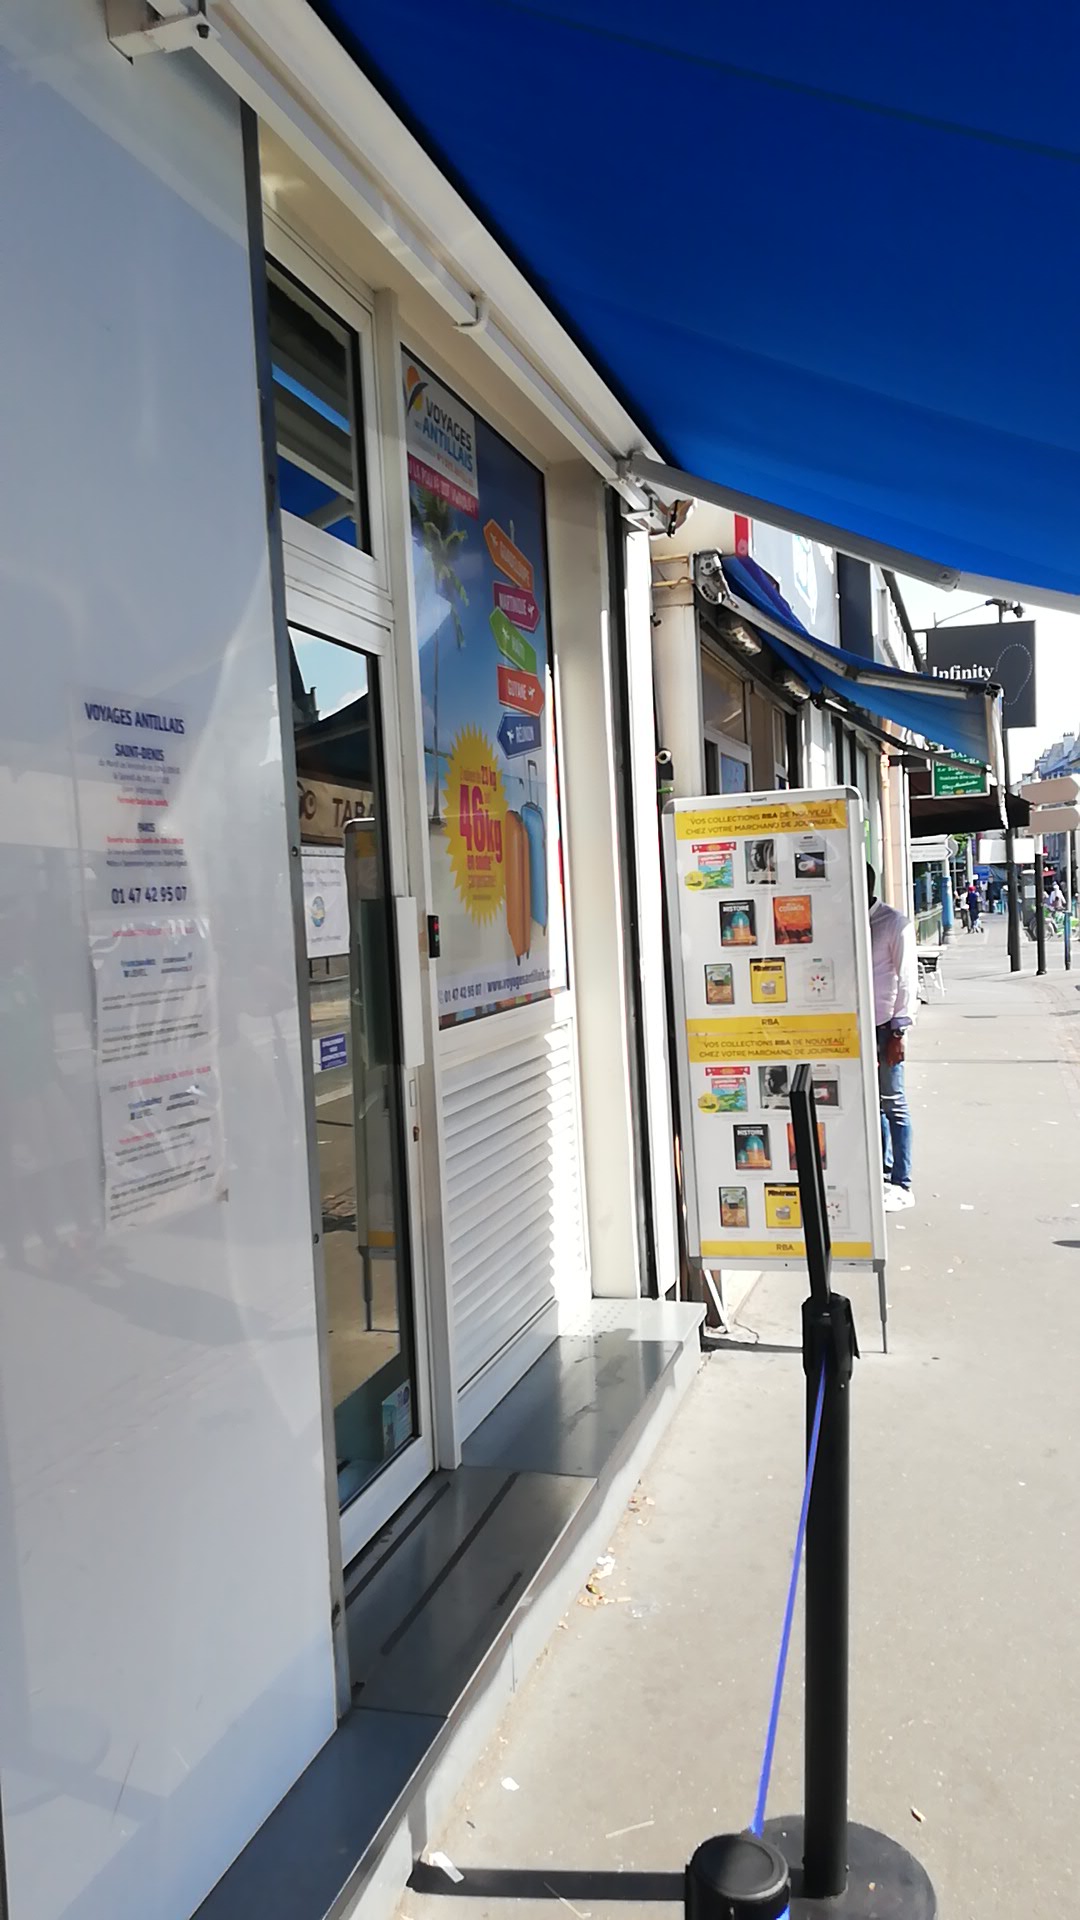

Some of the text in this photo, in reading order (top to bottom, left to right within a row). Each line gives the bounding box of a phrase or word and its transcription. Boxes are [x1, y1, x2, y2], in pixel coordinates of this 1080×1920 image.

[426, 396, 472, 452] VOYAGES
[423, 417, 473, 472] ANTILLAIS
[932, 664, 994, 681] Infinity
[507, 679, 528, 700] GUYANE
[84, 702, 185, 734] VOYAGES ANTILLAIS
[115, 743, 165, 761] SAINT-DENIS
[690, 817, 706, 825] VOS
[707, 814, 760, 824] COLLECTIONS
[779, 811, 791, 819] DE
[686, 827, 705, 835] CHEZ
[708, 825, 734, 834] VOTRE
[734, 822, 780, 831] MARCHAND
[781, 821, 790, 829] DE
[112, 886, 187, 904] 01 47 42 95 07
[761, 1018, 779, 1026] RBA
[721, 1040, 773, 1048] COLLECTIONS
[805, 1037, 845, 1045] NOUVEAU
[699, 1050, 719, 1058] CHEZ
[807, 1047, 850, 1055] JOURNAUX
[776, 1243, 794, 1251] RBA
